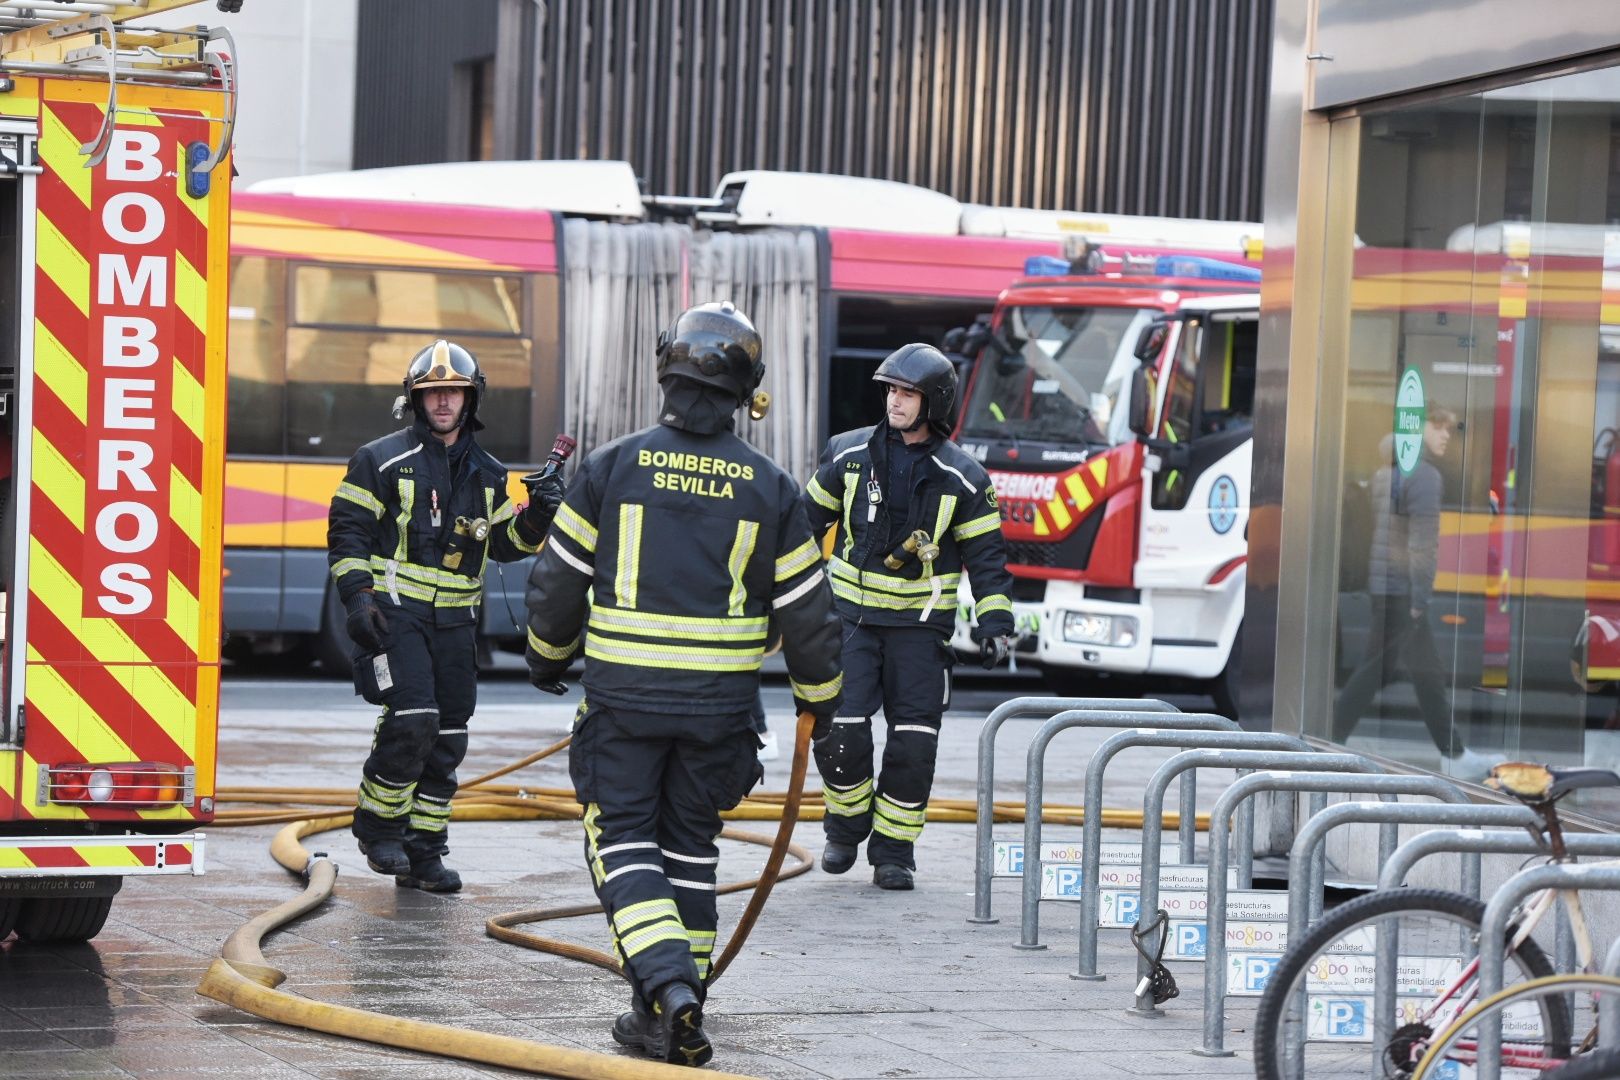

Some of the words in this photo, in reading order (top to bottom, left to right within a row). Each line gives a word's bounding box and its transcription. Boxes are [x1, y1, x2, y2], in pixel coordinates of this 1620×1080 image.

[94, 129, 168, 615] BOMBEROS
[1398, 411, 1420, 430] Metro
[638, 449, 754, 480] BOMBEROS
[653, 471, 734, 499] SEVILLA
[999, 502, 1036, 523] ECO
[1058, 869, 1077, 894] P
[1159, 875, 1204, 883] aestructuras
[1117, 895, 1137, 922] P
[1226, 901, 1272, 910] aestructuras
[1240, 910, 1288, 919] Sostenibilida
[1178, 926, 1200, 955] P
[1247, 959, 1270, 989] P
[1397, 976, 1446, 987] stenibilidad
[1329, 1002, 1353, 1034] P
